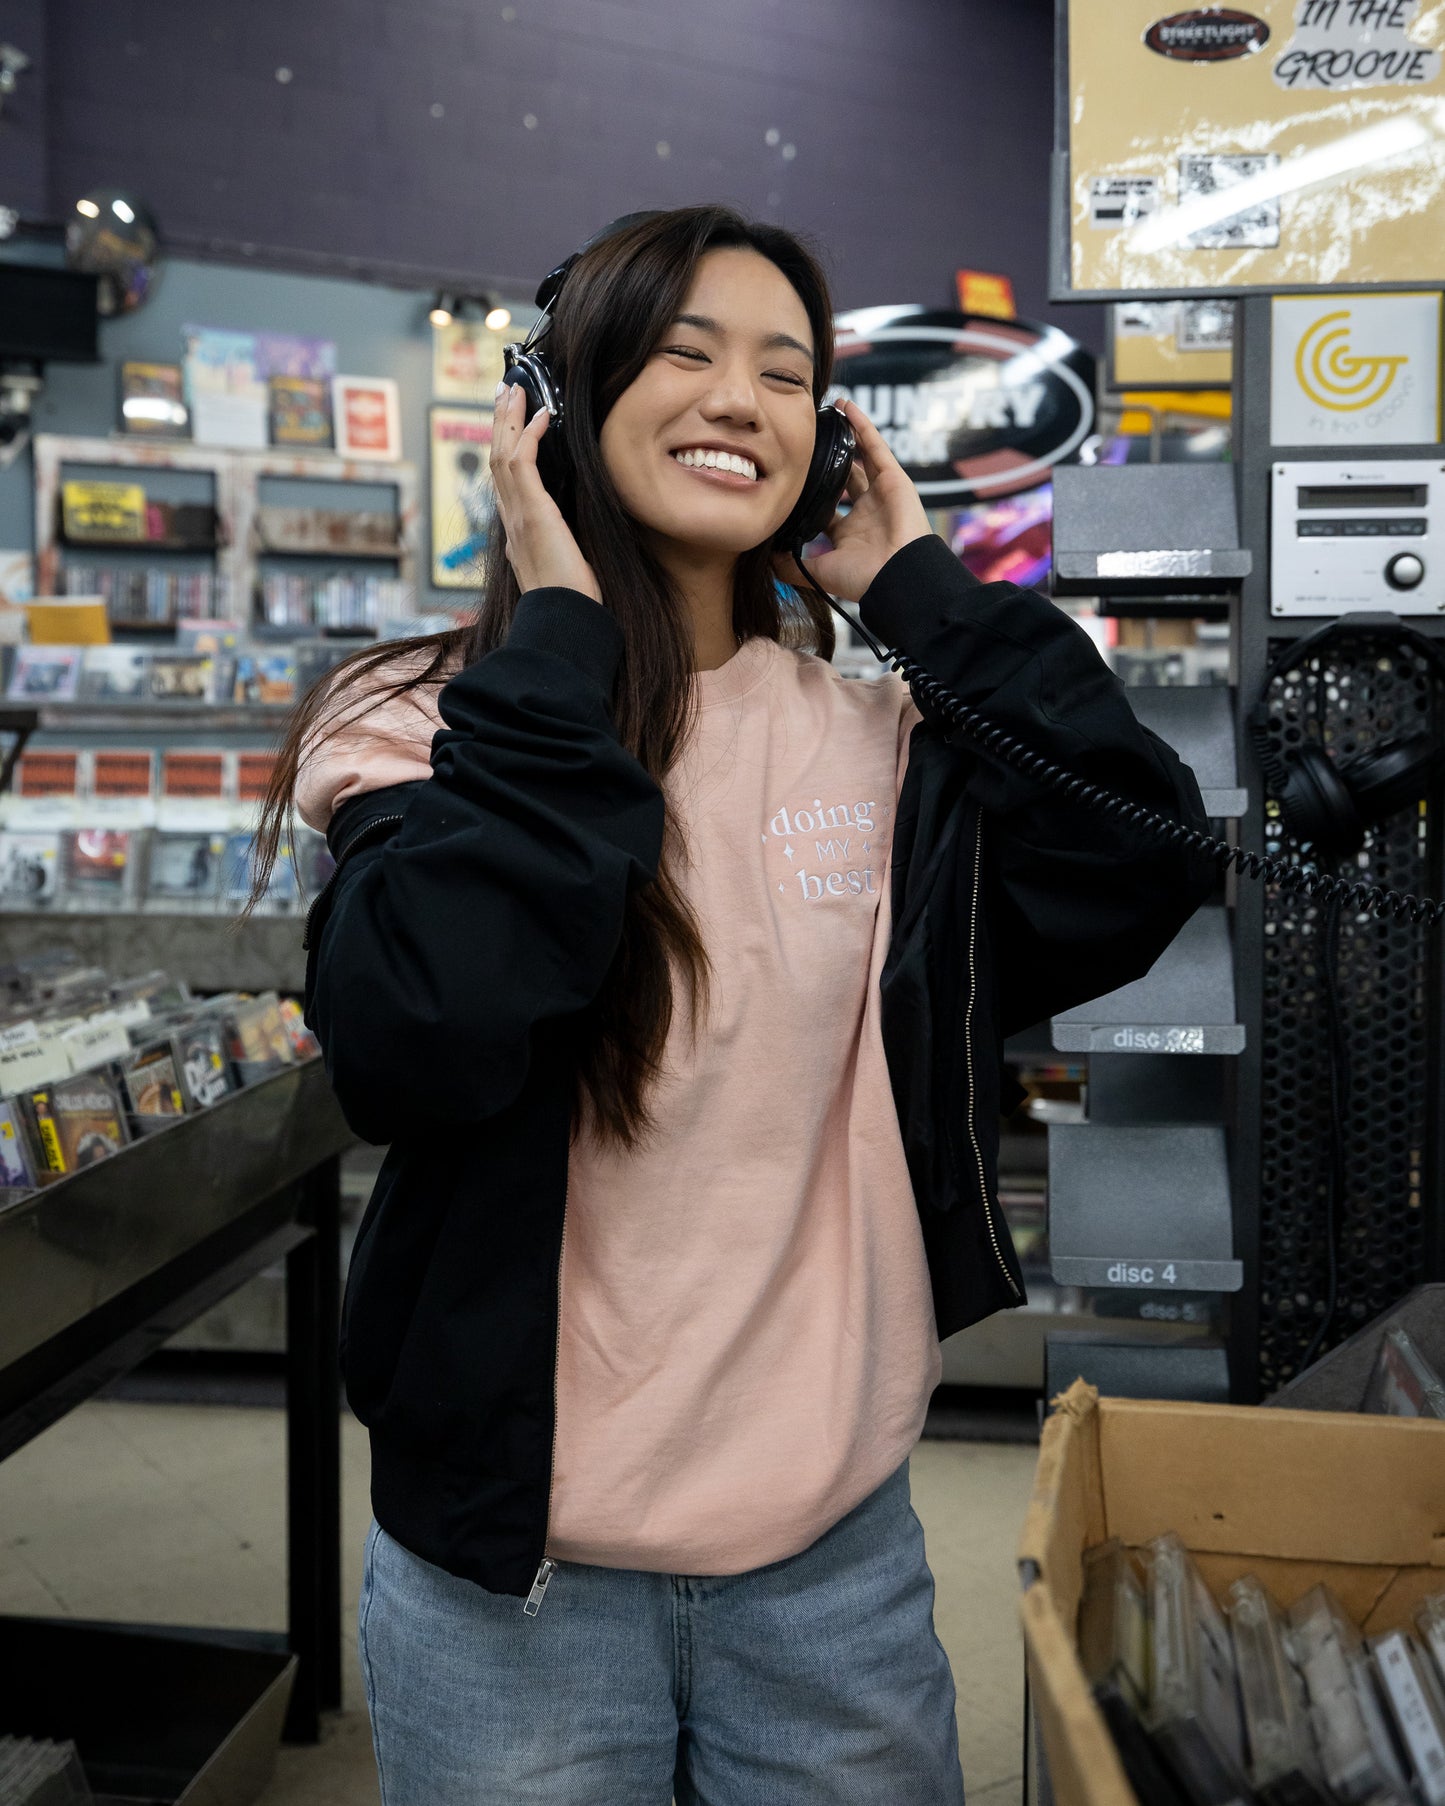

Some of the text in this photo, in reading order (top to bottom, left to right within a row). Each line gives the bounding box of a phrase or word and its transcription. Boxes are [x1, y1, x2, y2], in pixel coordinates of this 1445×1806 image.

[1298, 0, 1413, 30] IN THE
[1160, 24, 1257, 41] STREETLIGHT
[1275, 49, 1433, 86] GROOVE
[769, 798, 876, 836] doing
[815, 838, 850, 862] MY
[795, 865, 877, 901] best
[1113, 1028, 1160, 1049] disc
[1107, 1263, 1177, 1284] disc 4
